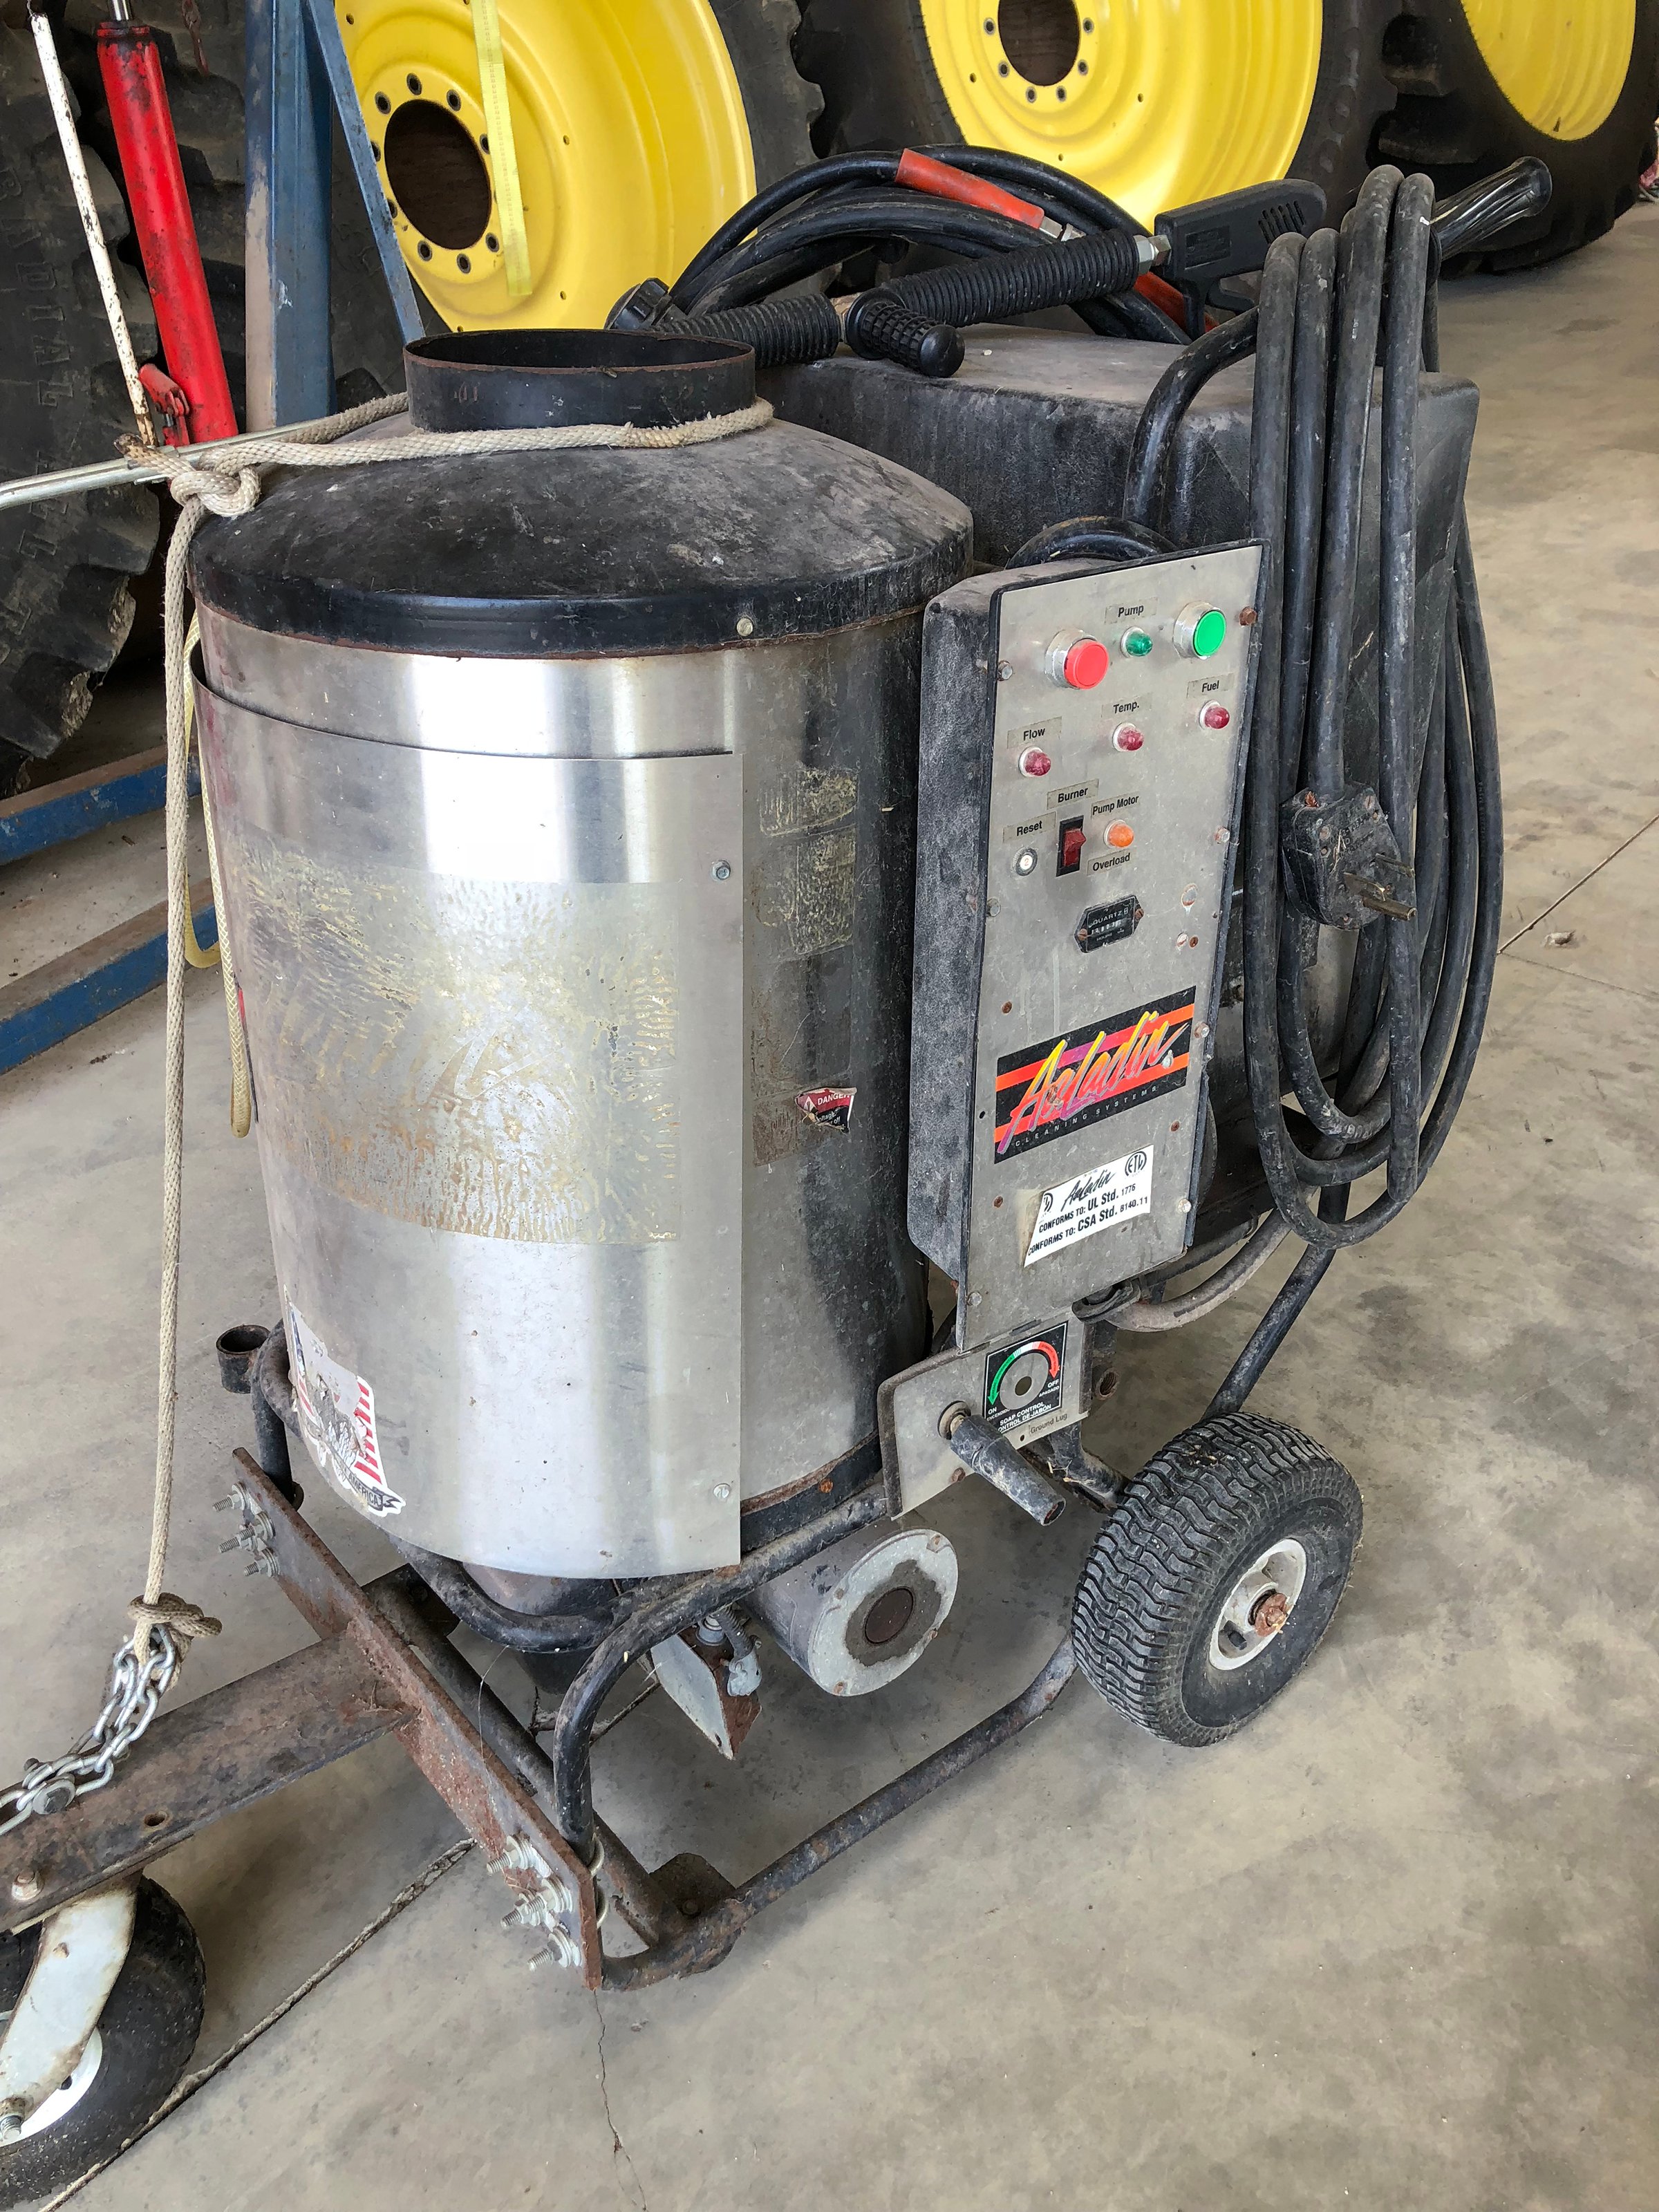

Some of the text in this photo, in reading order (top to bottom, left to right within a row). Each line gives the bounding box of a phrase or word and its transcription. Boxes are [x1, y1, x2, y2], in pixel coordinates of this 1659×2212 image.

[1118, 604, 1144, 617] Pump
[1201, 680, 1219, 693] Fuel
[1114, 700, 1139, 714] Temp.
[1023, 727, 1045, 741] Flow
[1058, 787, 1088, 803] Burner
[1092, 795, 1139, 816] Pump Motor
[1016, 820, 1042, 836] Reset
[1092, 853, 1130, 872] Overload
[1089, 910, 1123, 927] QUARTZ
[818, 1094, 850, 1105] DANGE
[1015, 1086, 1157, 1147] CLEANING SYSTEMS
[1039, 1183, 1136, 1233] CONFORMS TO: UL Std. 1776
[1028, 1197, 1148, 1256] CONFORMS TO: CSA Std. B140.11
[1048, 1379, 1059, 1388] OFF
[988, 1407, 997, 1415] ON
[1000, 1402, 1044, 1426] SOAP CONTROL
[997, 1418, 1021, 1432] ONTROL
[1022, 1413, 1030, 1421] DE
[1030, 1414, 1067, 1434] Ground Lug
[348, 1473, 379, 1506] AMERICA
